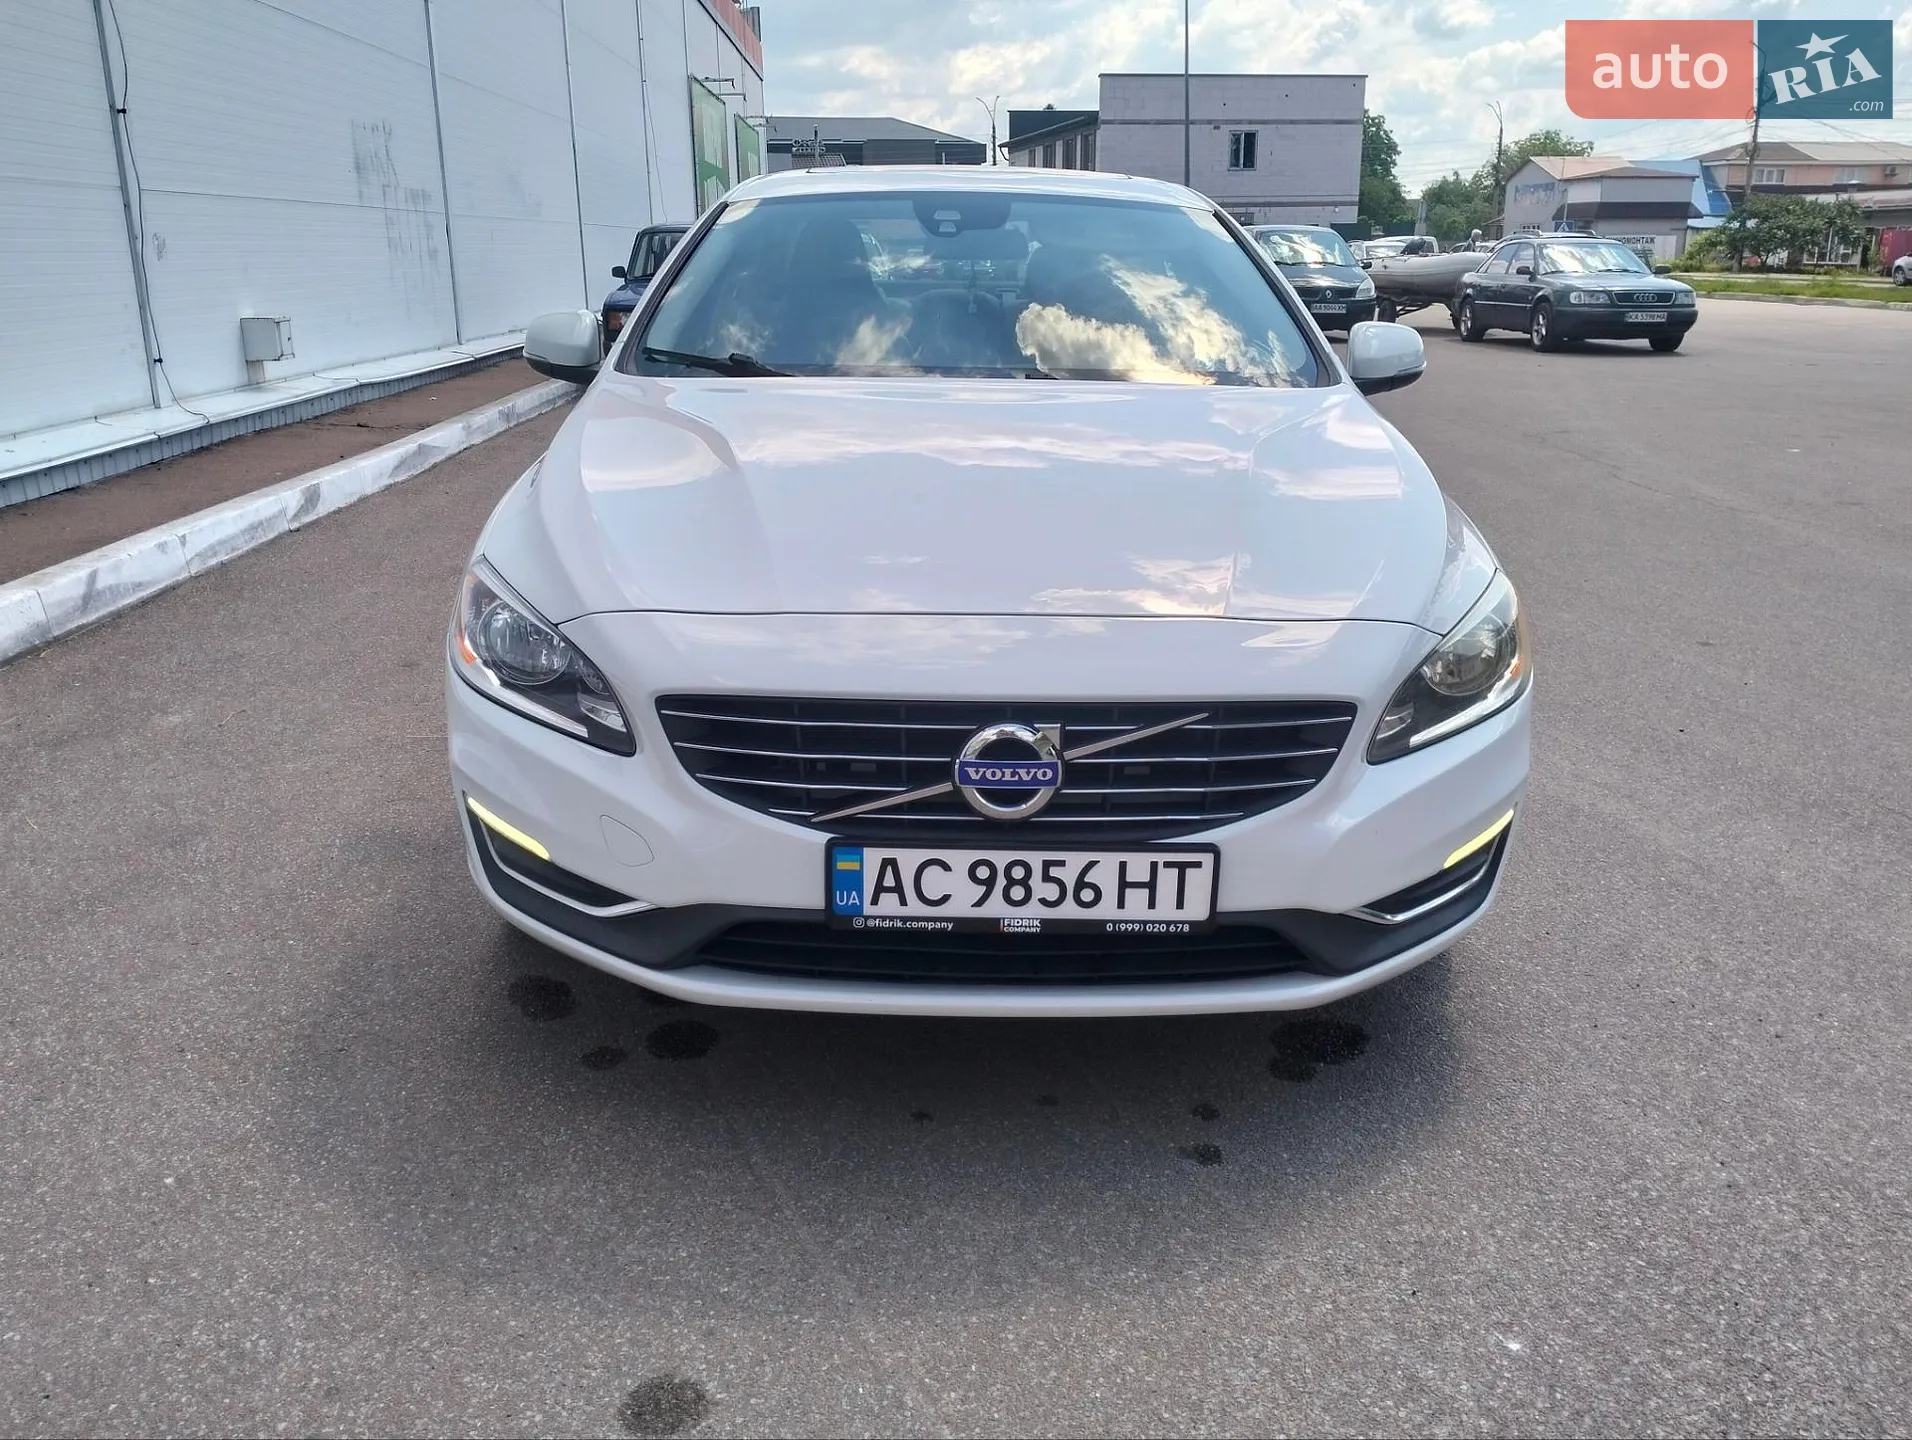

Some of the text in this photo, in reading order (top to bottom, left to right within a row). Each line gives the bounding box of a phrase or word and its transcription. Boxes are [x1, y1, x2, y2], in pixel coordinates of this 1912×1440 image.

[1607, 236, 1656, 245] НОМОНТАЖ
[965, 767, 1053, 781] VOLVO
[870, 857, 1203, 910] AC 9856 HT
[836, 890, 860, 906] UA
[866, 918, 954, 931] @fidrik.company
[1003, 918, 1041, 927] FIDRIK
[1106, 922, 1113, 932] 0
[1146, 923, 1167, 932] 020
[1169, 923, 1190, 932] 678
